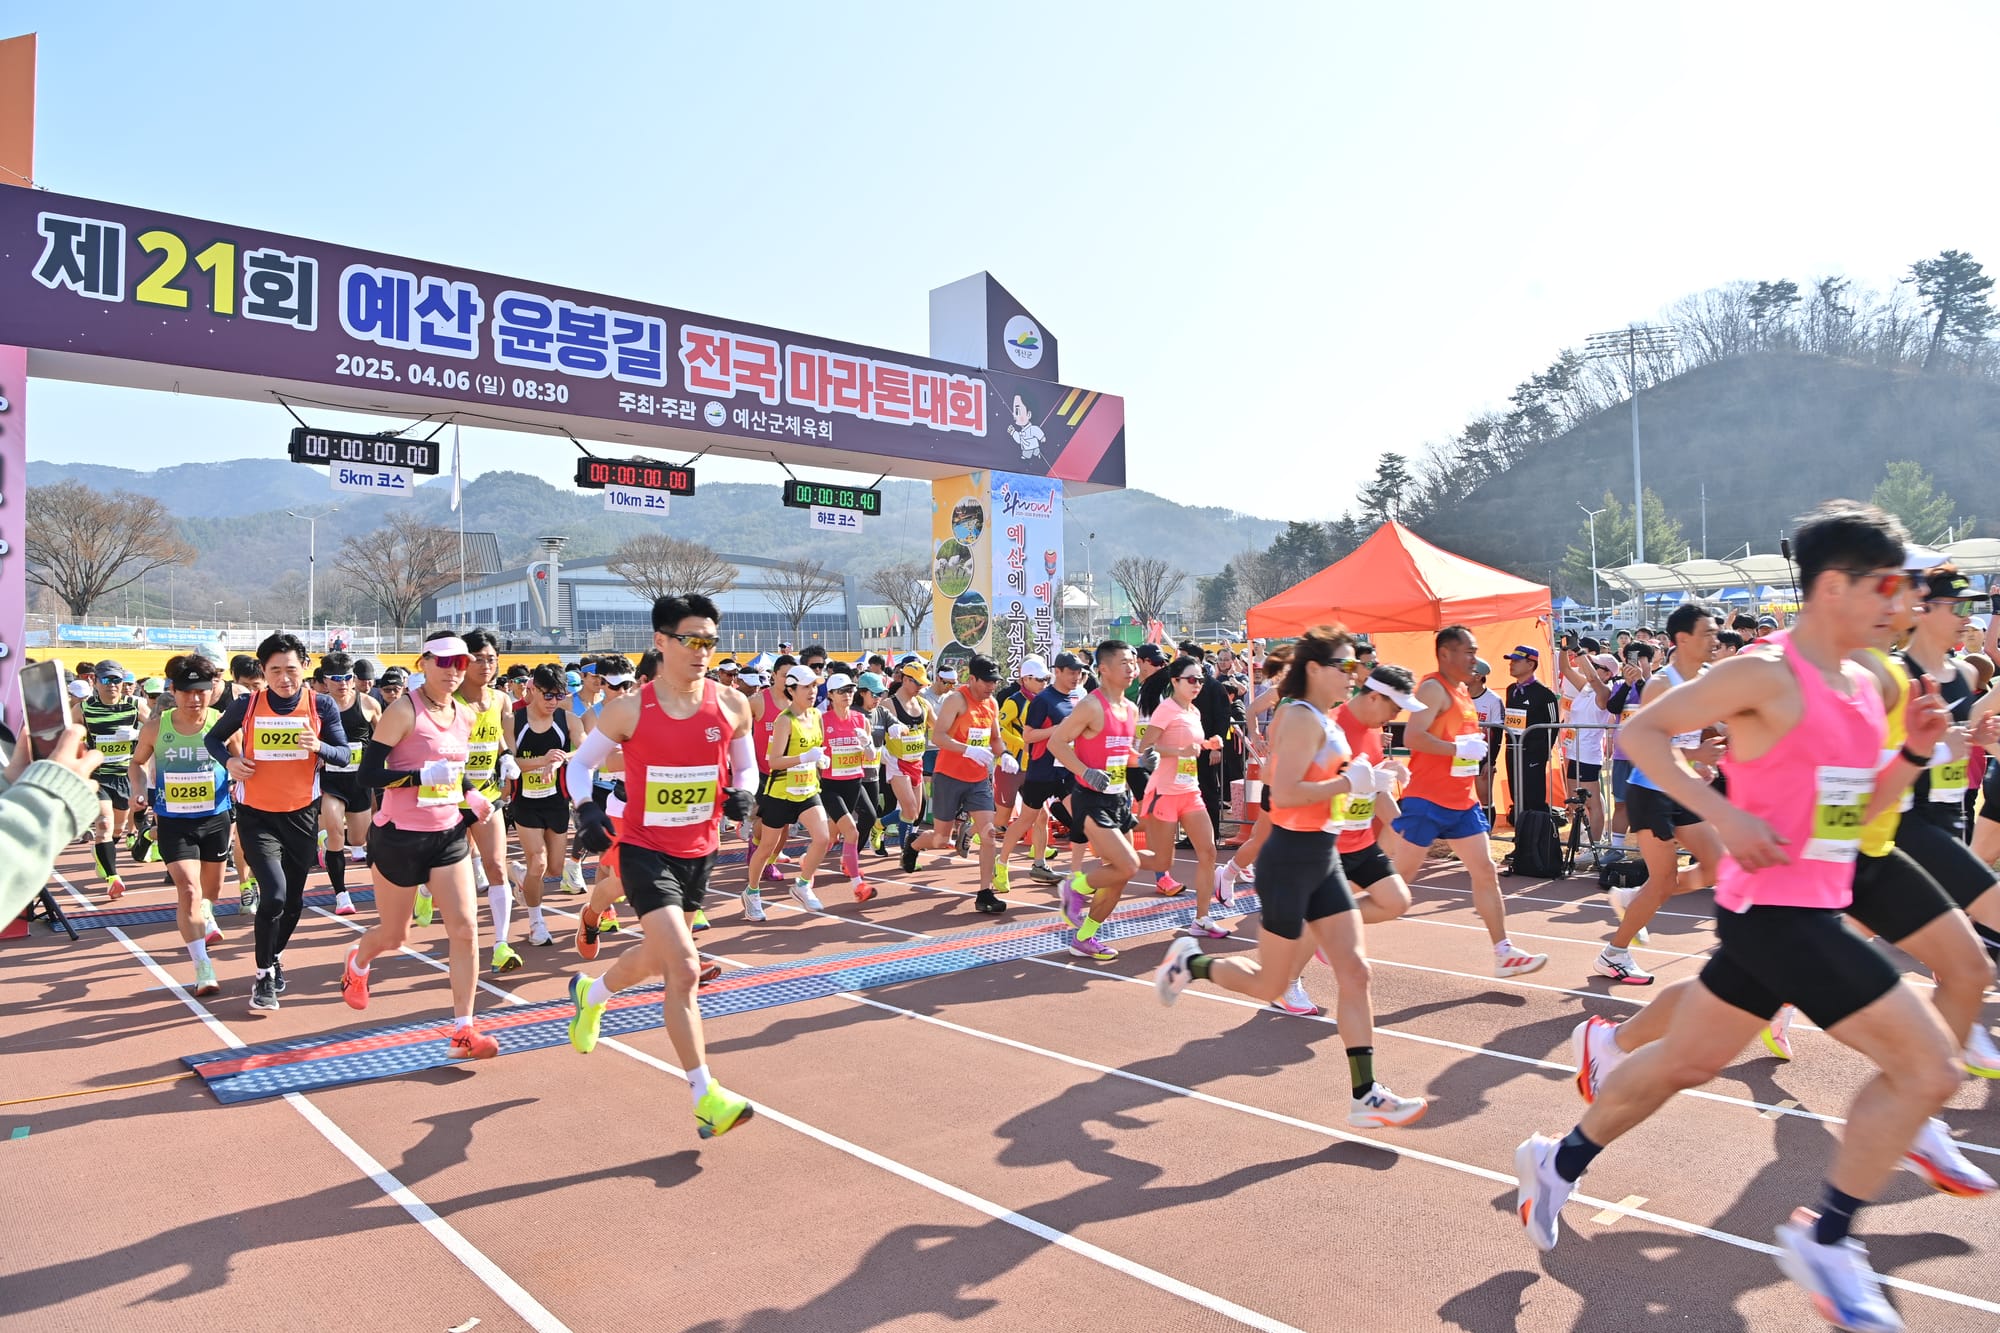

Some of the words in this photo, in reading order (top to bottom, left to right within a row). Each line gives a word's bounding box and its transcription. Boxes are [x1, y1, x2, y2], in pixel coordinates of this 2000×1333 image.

[32, 212, 318, 331] 제21회
[339, 264, 484, 359] 예산
[491, 290, 667, 387] 윤봉길
[679, 324, 782, 406] 전국
[785, 344, 987, 437] 마라톤대회
[335, 353, 401, 382] 2025.
[408, 364, 470, 391] 04.06
[475, 373, 505, 396] (일)
[512, 378, 569, 404] 08:30
[618, 391, 697, 421] 주최·주관
[732, 408, 833, 441] 예산군체육회
[339, 469, 373, 486] 5km
[377, 472, 405, 489] 코스
[609, 491, 642, 507] 10km
[644, 495, 665, 509] 코스
[817, 512, 836, 524] 하프
[838, 514, 856, 527] 코스
[1007, 523, 1026, 594] 예산에
[261, 732, 300, 745] 0920
[101, 744, 127, 753] 0826
[467, 755, 493, 766] 295
[170, 786, 208, 799] 0288
[657, 788, 708, 805] 0827
